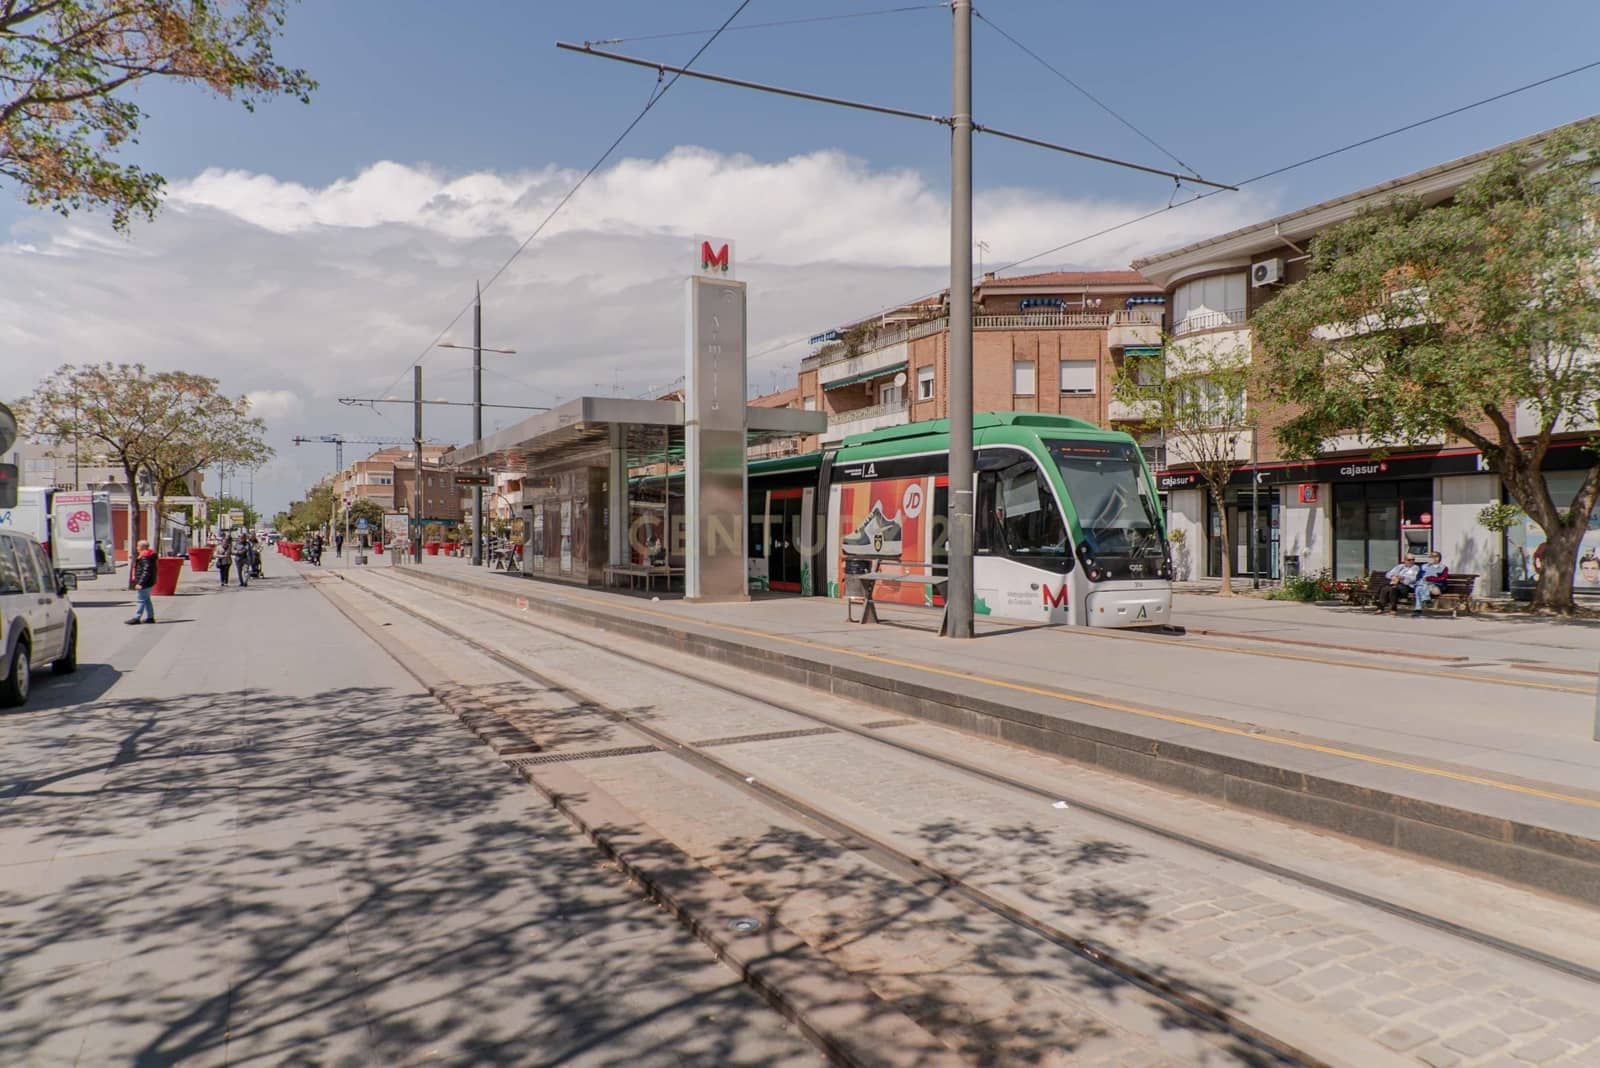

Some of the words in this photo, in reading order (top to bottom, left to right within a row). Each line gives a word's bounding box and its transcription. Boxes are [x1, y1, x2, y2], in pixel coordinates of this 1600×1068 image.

[701, 240, 729, 271] M
[1340, 464, 1379, 477] cajasur
[1161, 475, 1189, 487] cajasur
[906, 492, 921, 509] JD
[1042, 583, 1069, 612] M
